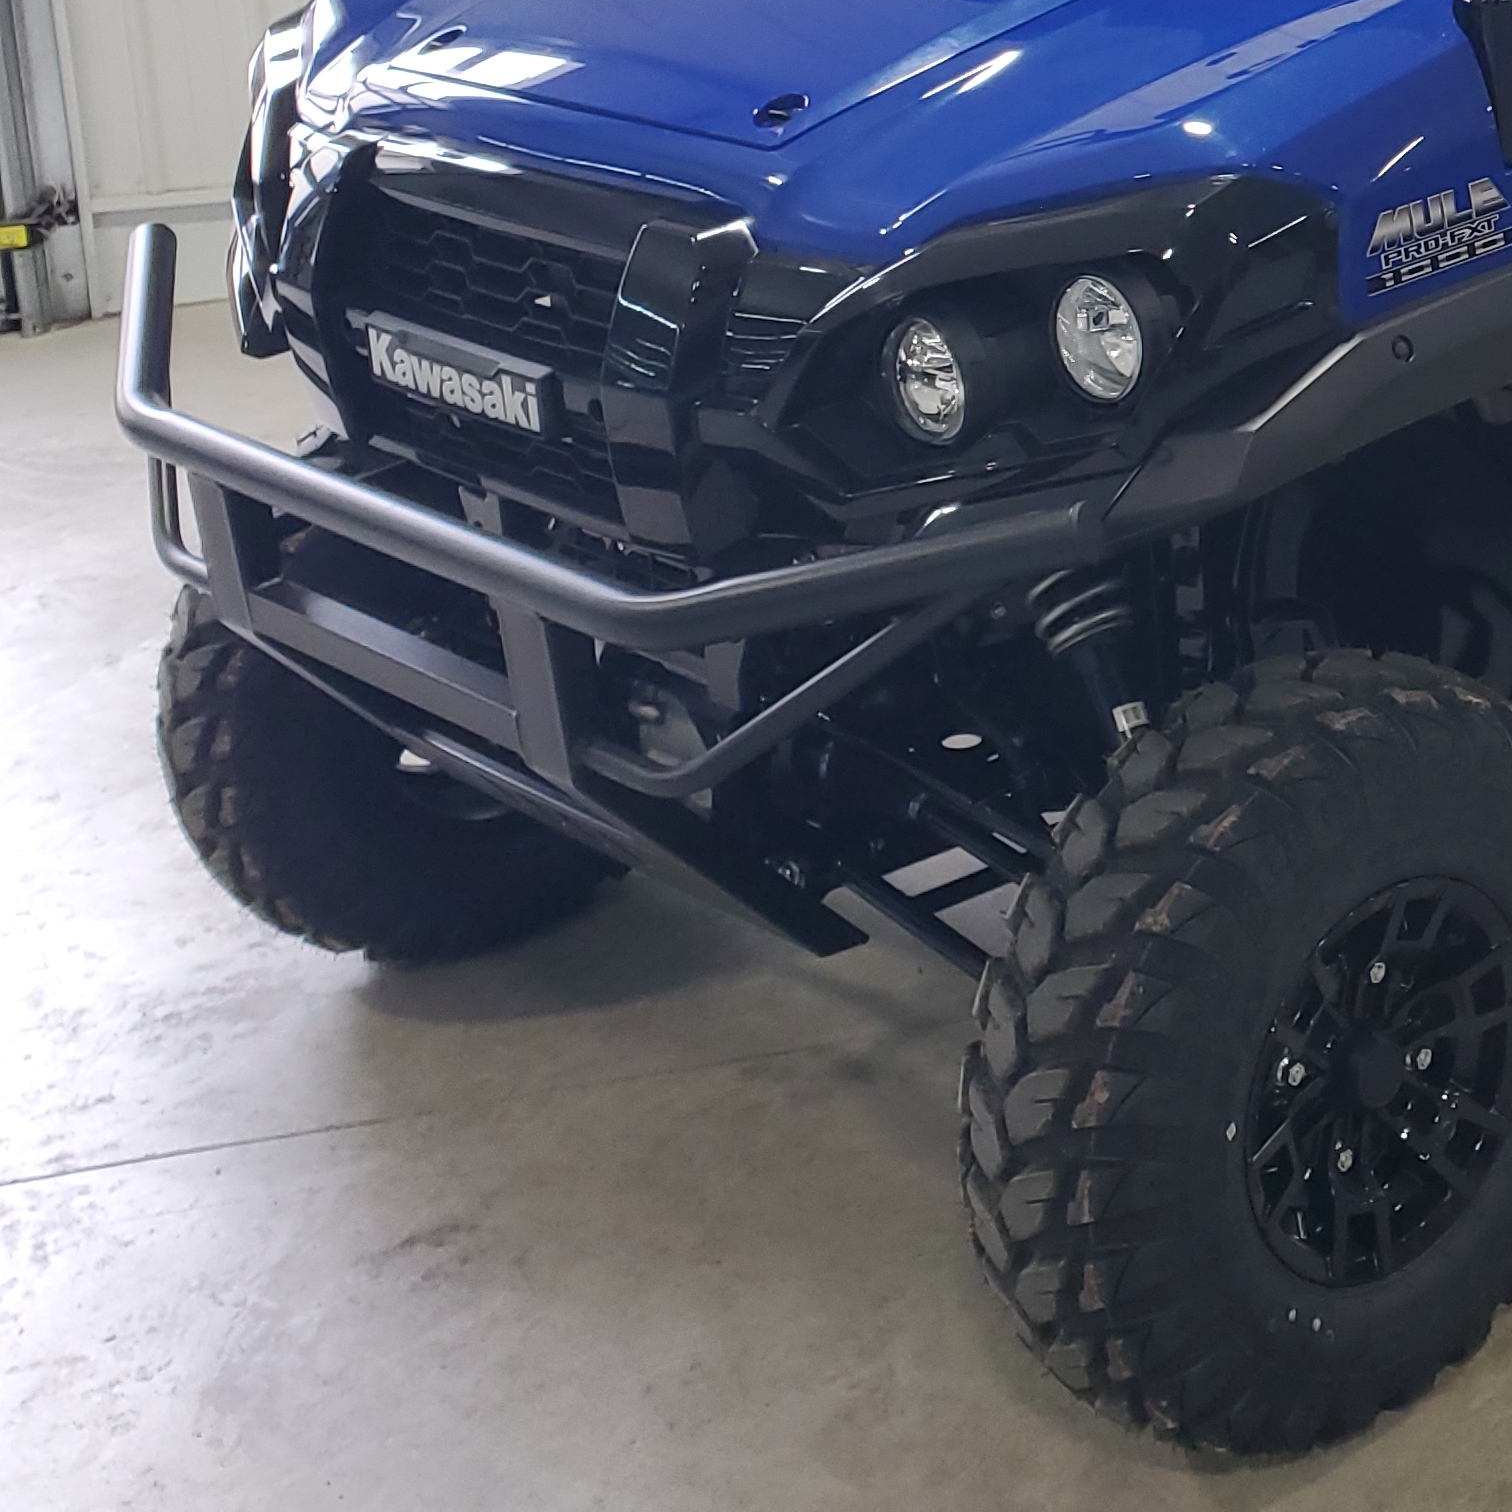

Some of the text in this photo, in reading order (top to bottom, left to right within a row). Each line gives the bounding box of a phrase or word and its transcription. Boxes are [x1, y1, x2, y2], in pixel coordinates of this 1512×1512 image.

[1366, 176, 1511, 257] MULE
[1380, 213, 1499, 270] PRO-FXT
[1382, 232, 1506, 289] 1000
[367, 326, 541, 433] Kawasaki
